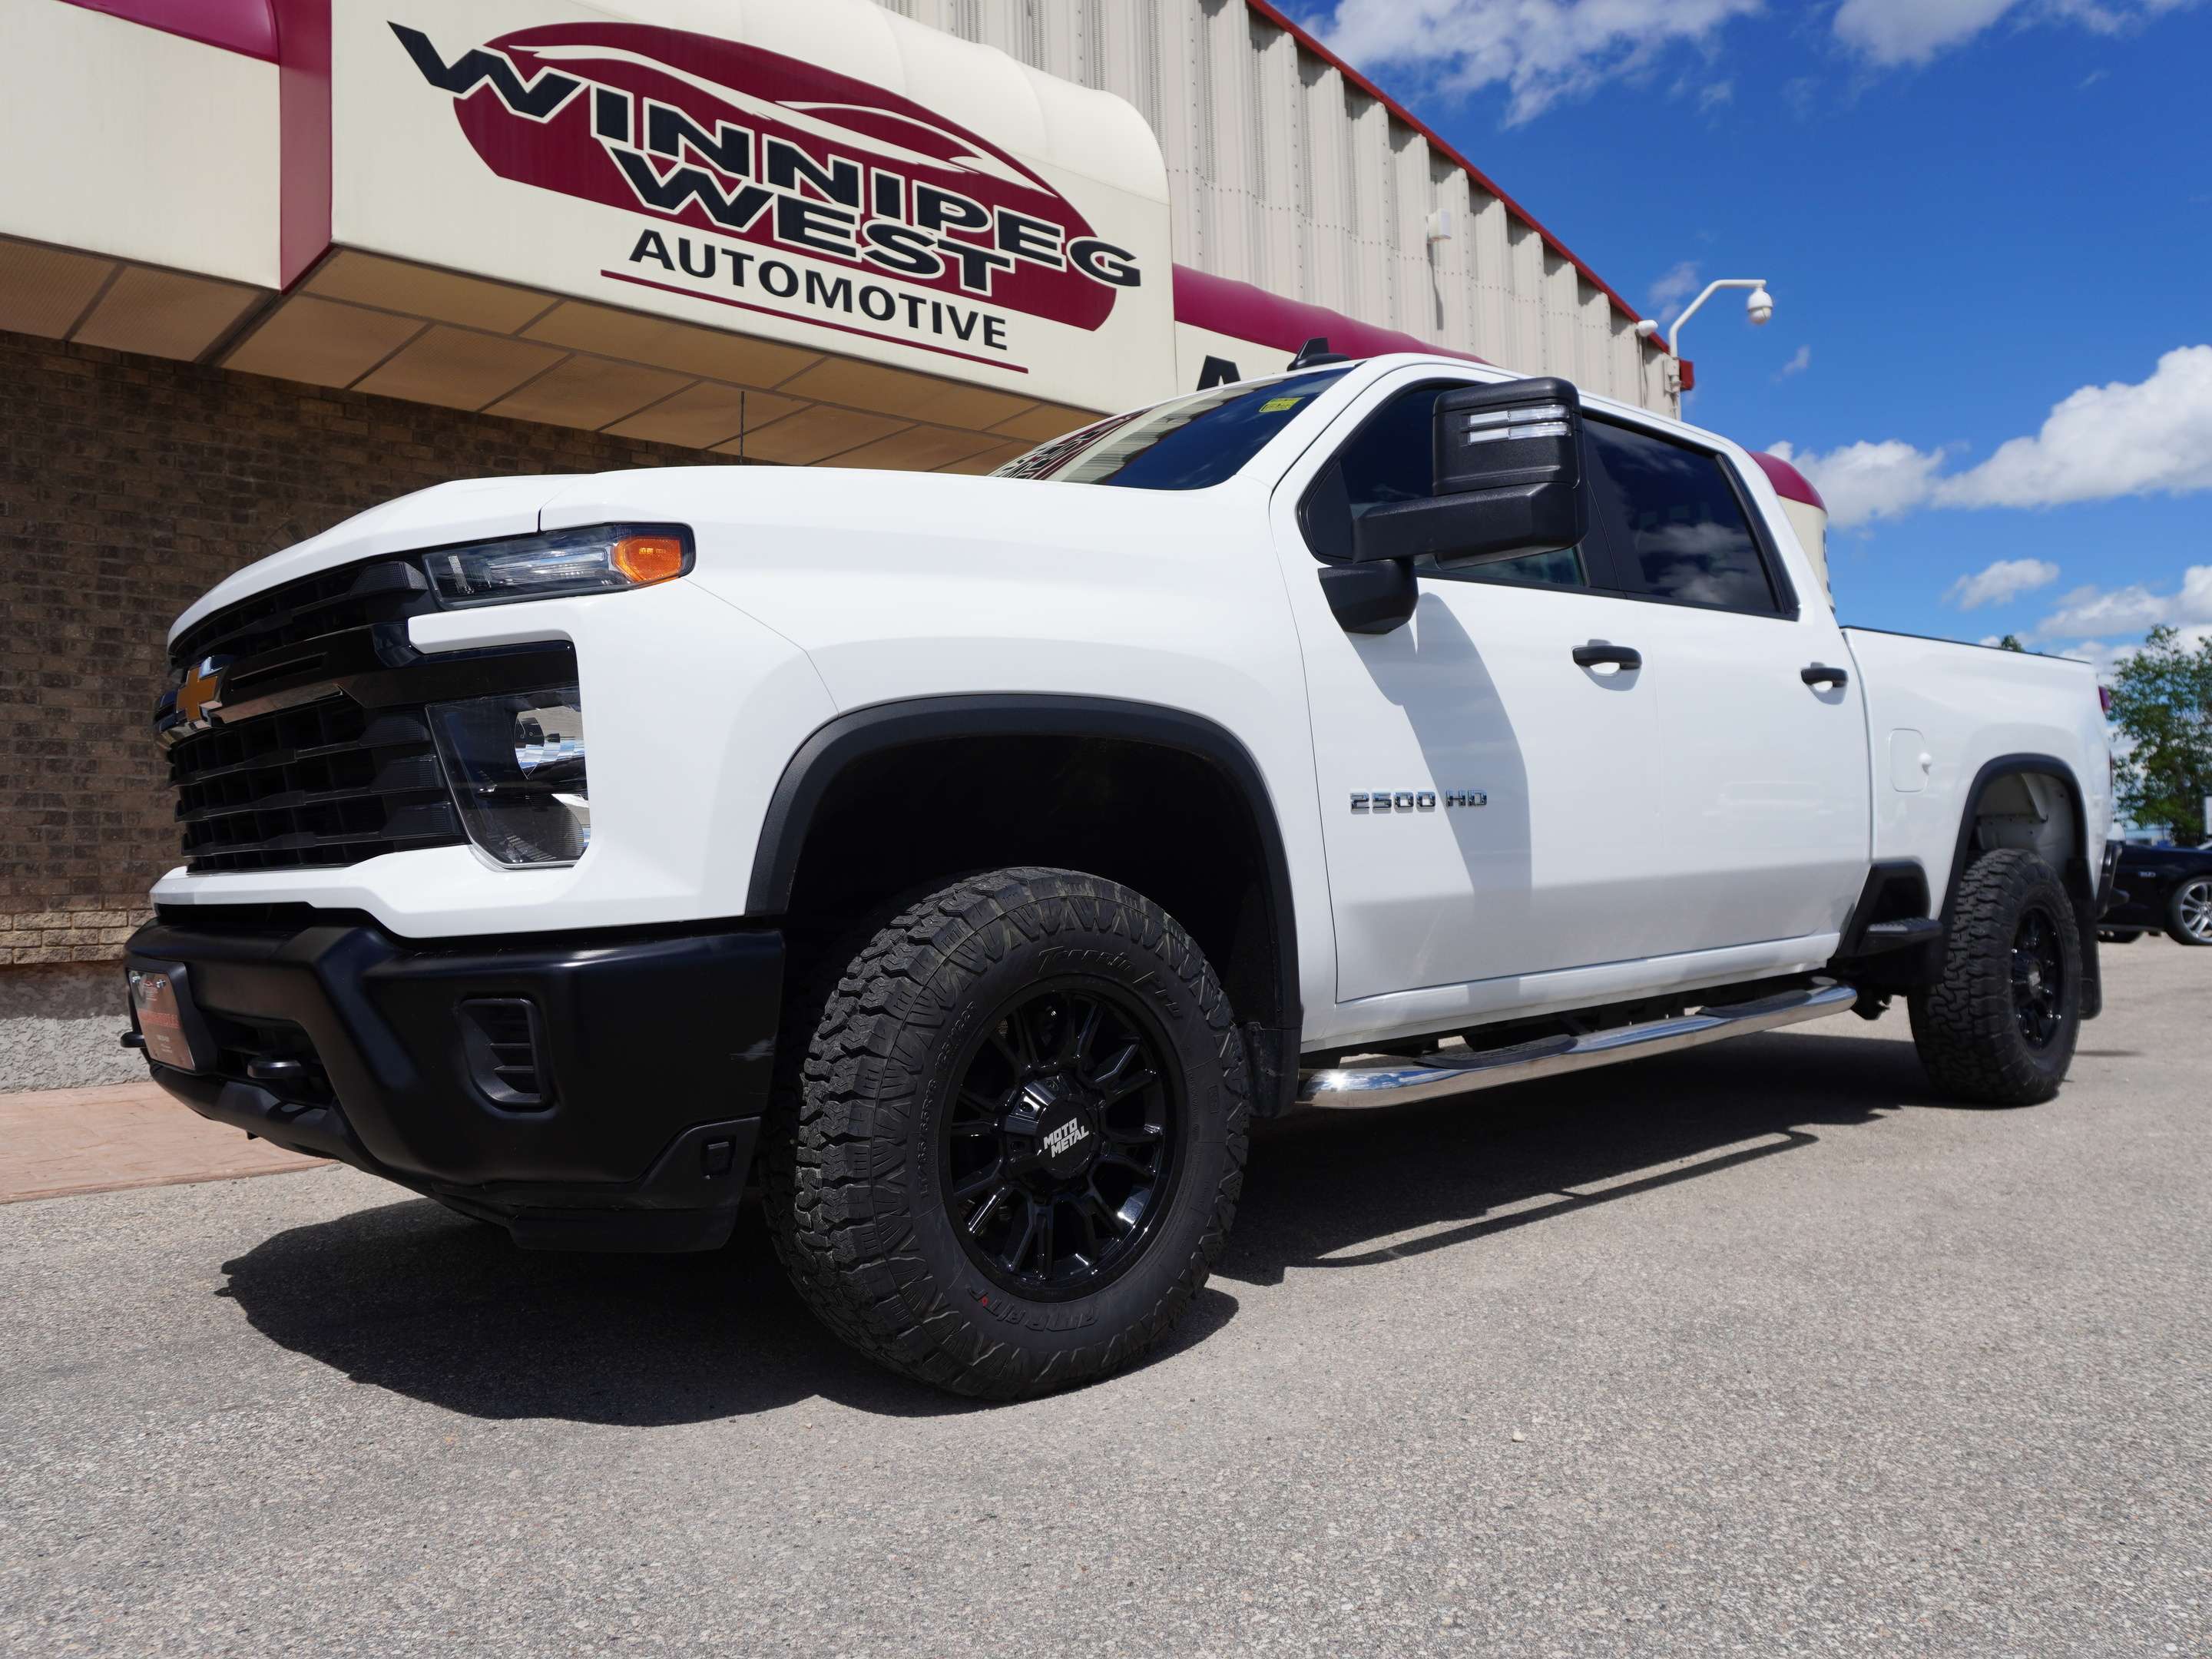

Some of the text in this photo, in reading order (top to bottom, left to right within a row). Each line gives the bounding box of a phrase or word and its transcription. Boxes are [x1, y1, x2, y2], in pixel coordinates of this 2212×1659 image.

[387, 20, 1141, 288] WINNIPEG
[608, 146, 1015, 296] WEST
[630, 229, 1008, 351] AUTOMOTIVE
[1349, 790, 1488, 809] 2500 HD
[1044, 1118, 1077, 1150] MOTO
[1051, 1125, 1089, 1158] METAL
